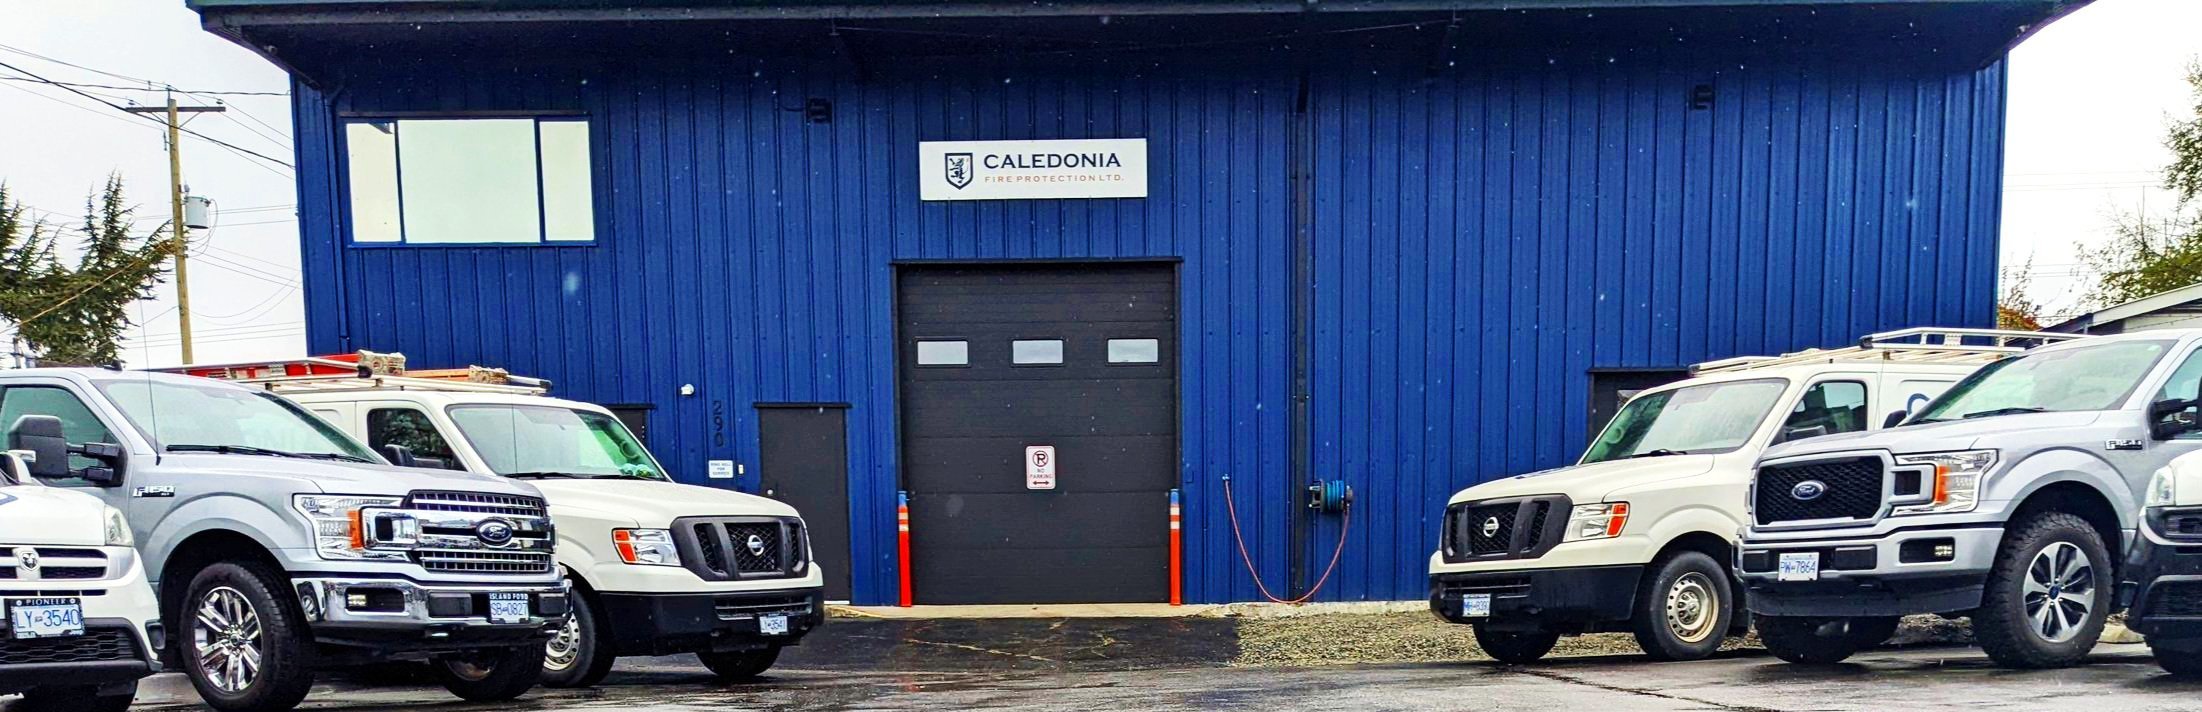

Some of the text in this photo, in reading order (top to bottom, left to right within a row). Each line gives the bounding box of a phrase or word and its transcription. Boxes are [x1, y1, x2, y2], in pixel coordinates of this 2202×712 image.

[983, 152, 1122, 169] CALEDONIA
[984, 174, 1125, 183] FIRE PROTECTION LTD.
[712, 400, 724, 448] 290
